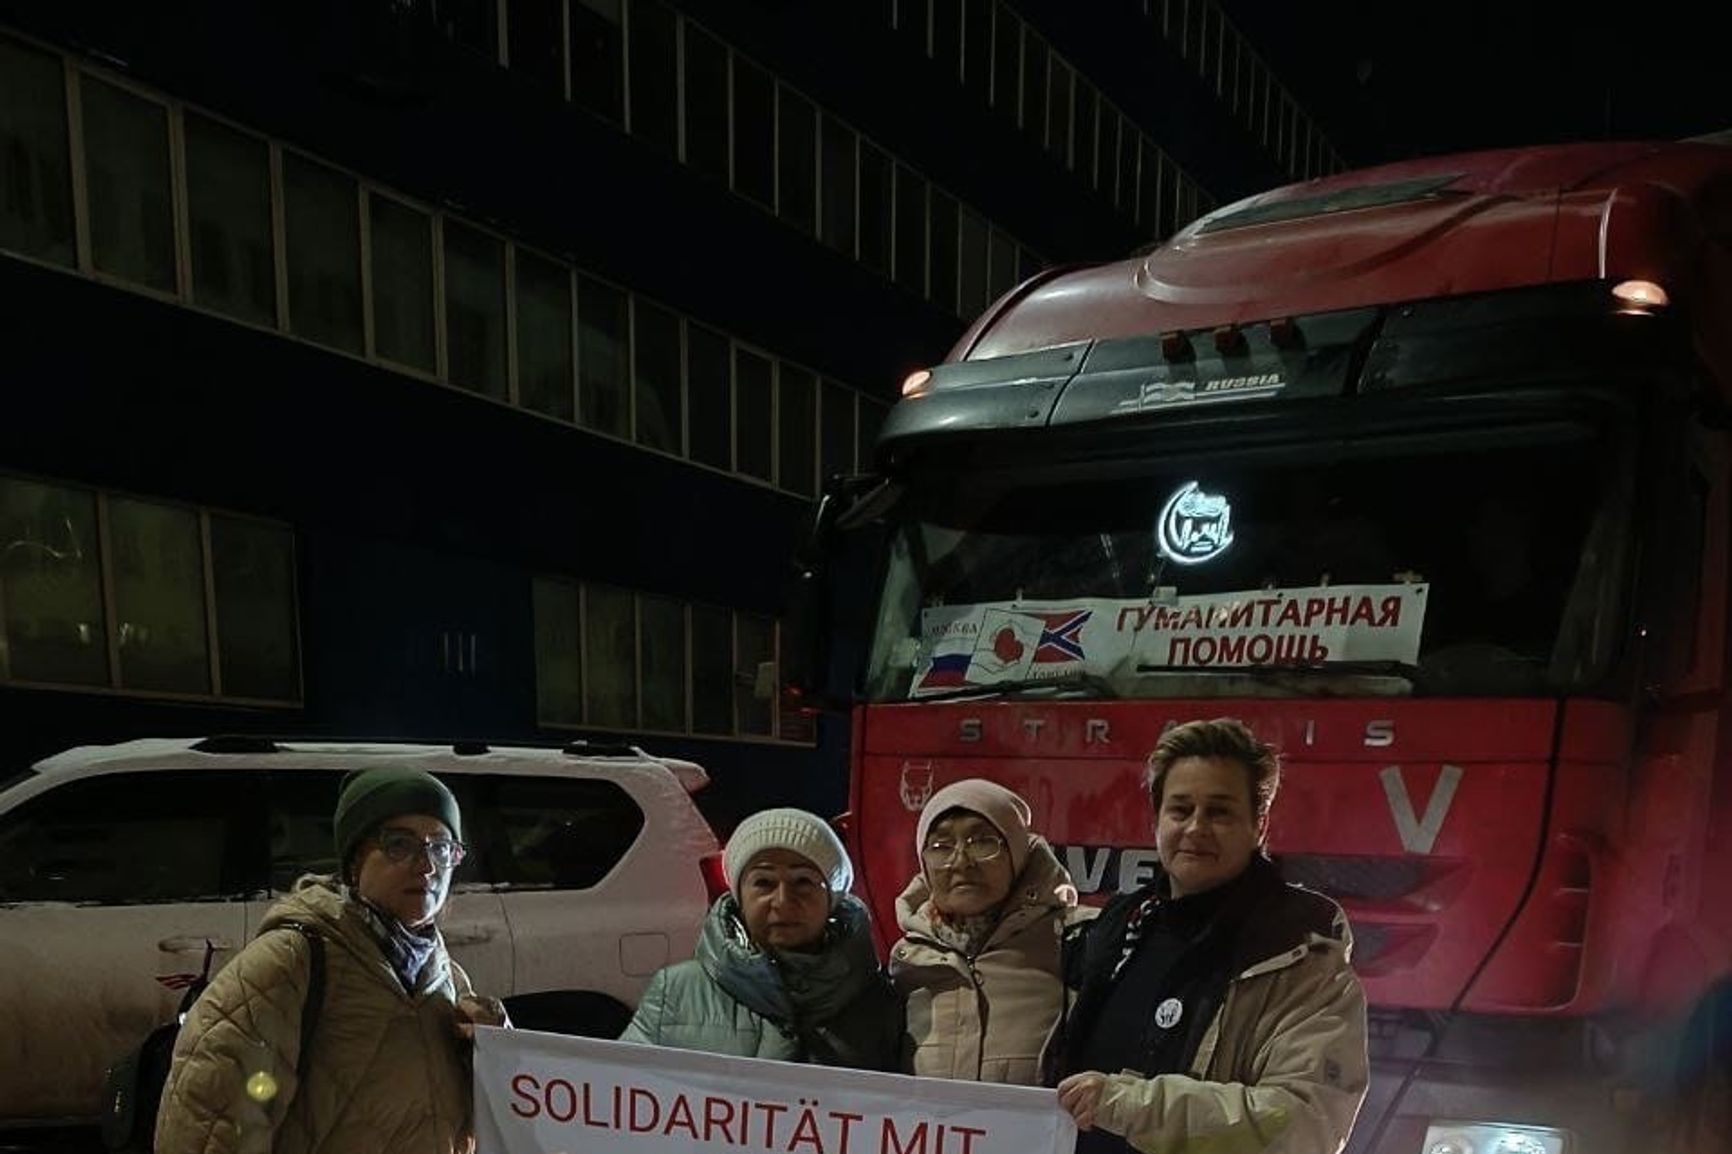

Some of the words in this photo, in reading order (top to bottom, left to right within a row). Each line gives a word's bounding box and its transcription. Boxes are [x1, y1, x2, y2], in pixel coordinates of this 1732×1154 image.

[1205, 373, 1280, 391] RUSSIA
[1116, 595, 1402, 632] ГУМАНИТАРНАЯ
[1167, 633, 1329, 666] ПОМОЩЬ
[960, 718, 1395, 747] STRIS
[1379, 764, 1463, 855] V
